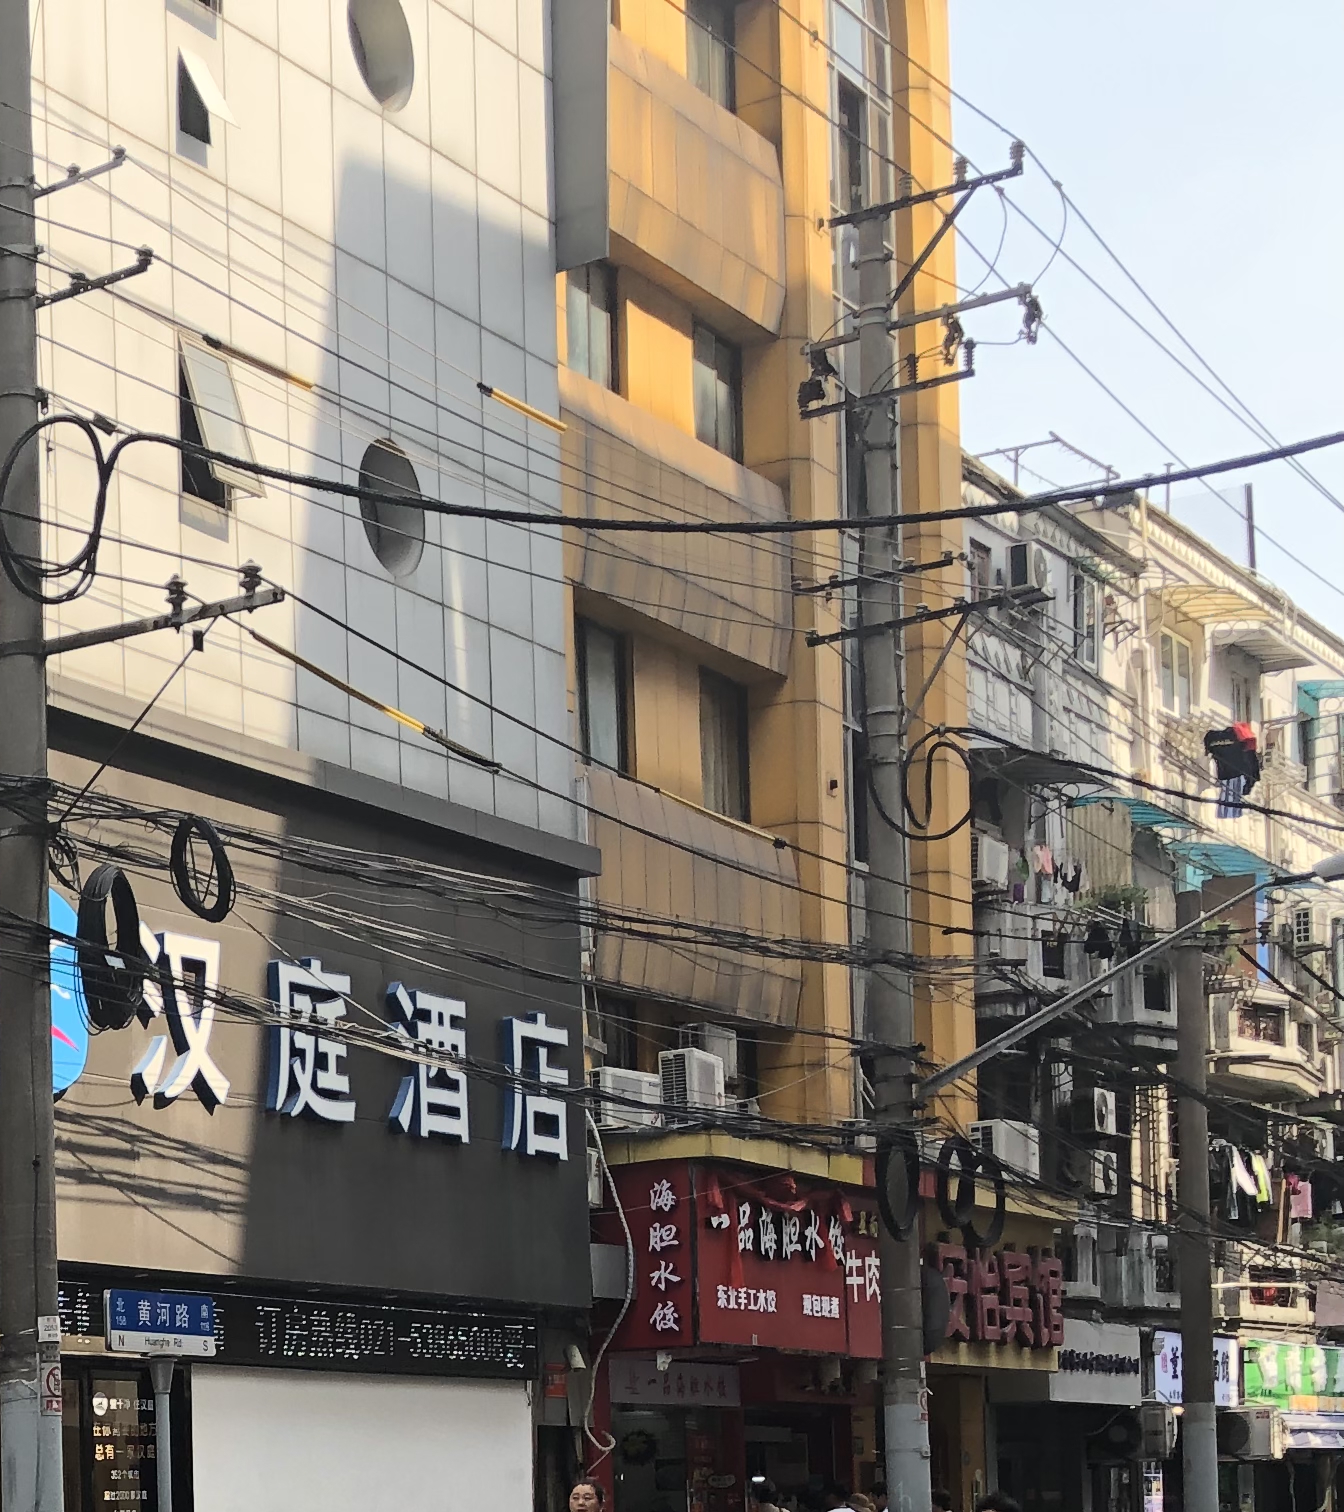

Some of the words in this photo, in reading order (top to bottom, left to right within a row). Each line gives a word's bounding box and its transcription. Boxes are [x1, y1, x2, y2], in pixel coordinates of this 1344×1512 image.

[130, 920, 570, 1162] 汉庭酒店
[648, 1178, 682, 1332] 海胆水饺
[845, 1249, 882, 1304] 牛肉
[116, 1297, 126, 1313] 北
[716, 1284, 778, 1313] 东北手工水饺
[137, 1299, 190, 1329] 黄河路
[200, 1303, 209, 1319] 南
[118, 1334, 125, 1347] N
[202, 1340, 209, 1352] S
[94, 1443, 156, 1461] 总有一家汉庭
